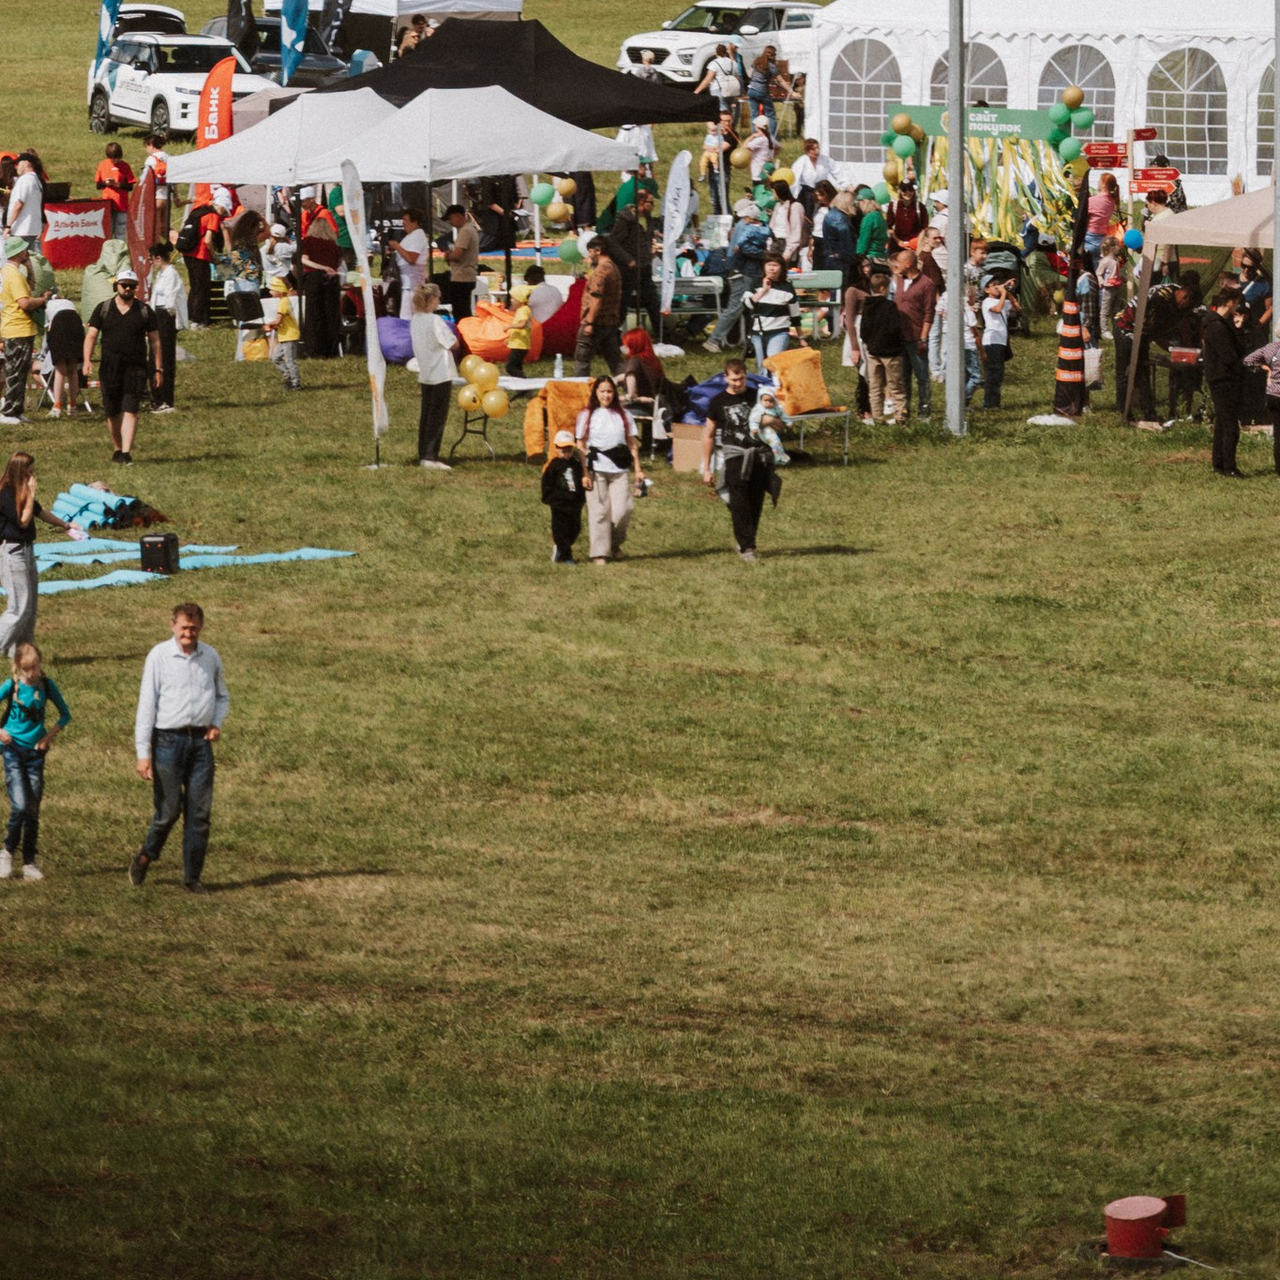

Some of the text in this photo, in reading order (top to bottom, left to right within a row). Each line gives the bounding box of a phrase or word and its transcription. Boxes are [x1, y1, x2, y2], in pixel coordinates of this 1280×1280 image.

[204, 87, 219, 139] Банк
[969, 110, 998, 122] сайт
[969, 122, 1021, 136] покупок
[54, 219, 98, 230] Альфа Банк
